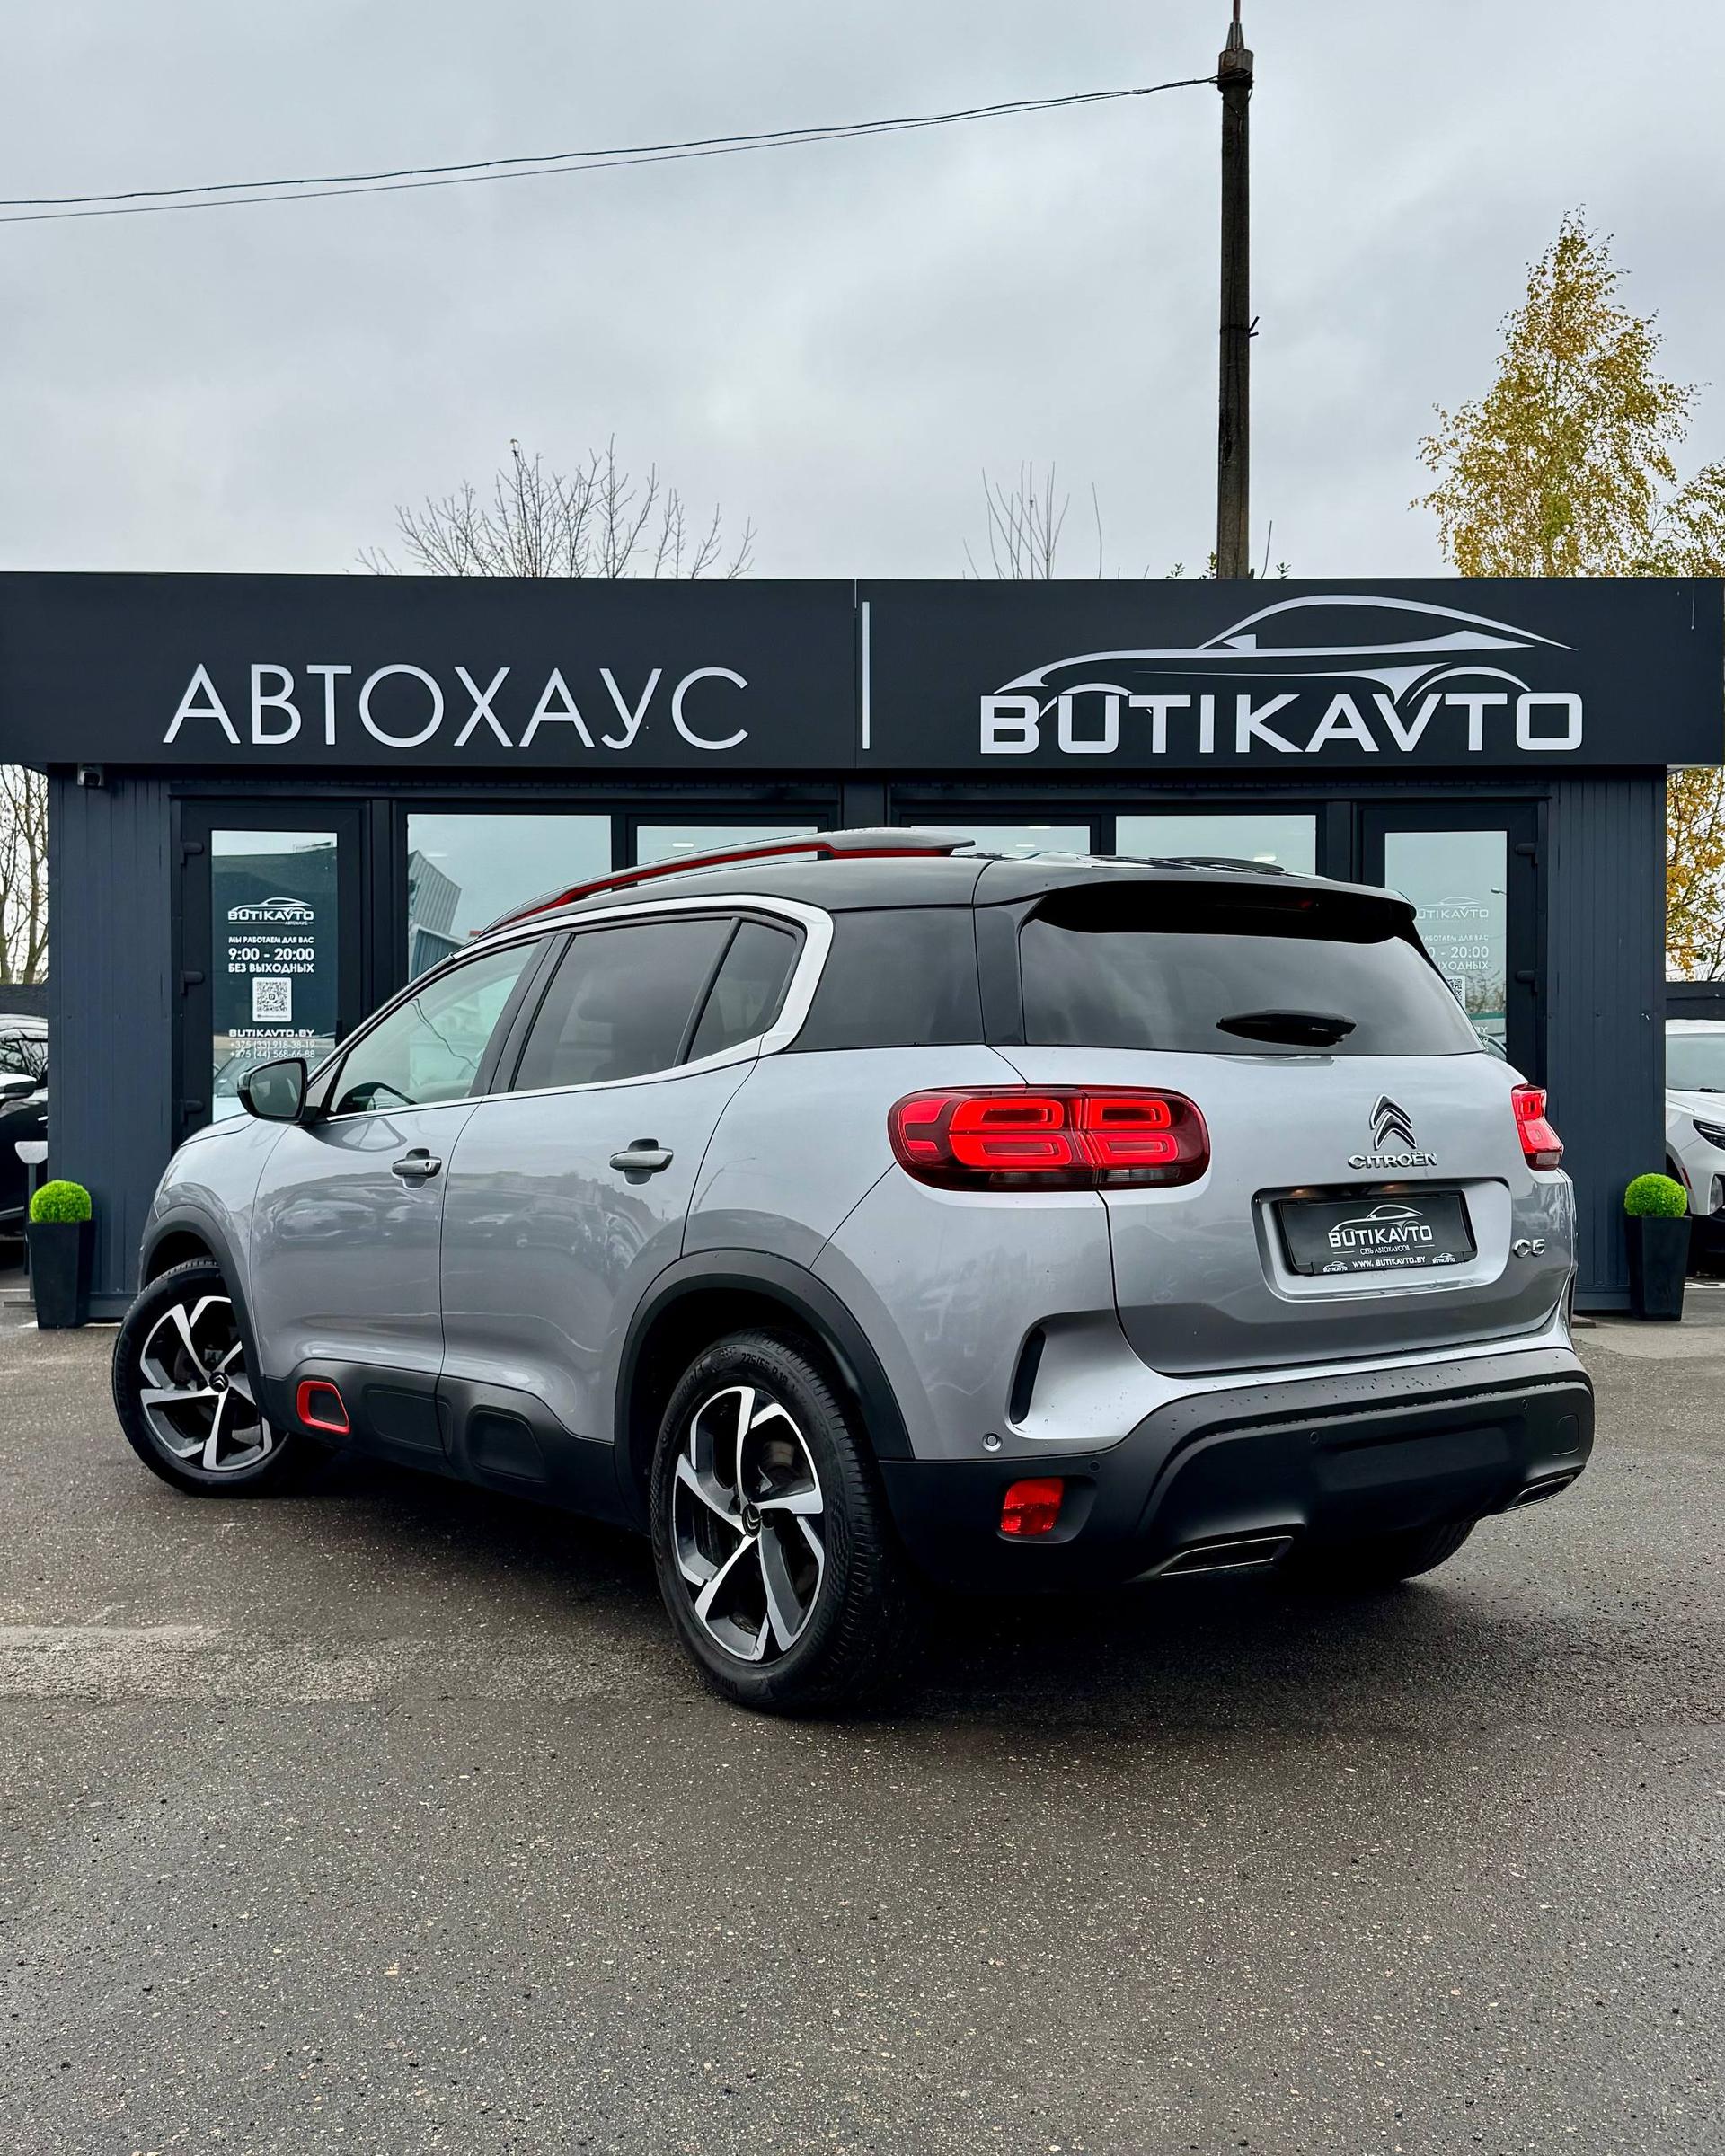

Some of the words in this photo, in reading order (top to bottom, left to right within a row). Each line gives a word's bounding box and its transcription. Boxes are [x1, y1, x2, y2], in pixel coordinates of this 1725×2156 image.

[163, 663, 749, 750] АВТОХАУС
[980, 692, 1584, 755] BUTIKAVTO
[227, 910, 314, 921] BUTIKAVTO
[1417, 909, 1489, 919] UTIKAVTO
[228, 936, 243, 944] МЫ
[243, 936, 281, 944] РАБОТАЕМ
[281, 936, 297, 944] ДЛЯ
[298, 936, 314, 944] ВАС
[228, 947, 260, 961] 9:00
[273, 947, 314, 961] 20:00
[1450, 945, 1490, 959] 20:00
[228, 963, 246, 973] БЕЗ
[248, 963, 314, 974] ВЫХОДНЫХ
[1438, 960, 1489, 970] ХОДНЫХ
[228, 1029, 315, 1038] BUTIKAVTO.BY
[253, 1049, 270, 1060] (44)
[272, 1049, 315, 1058] 568-66-88
[1348, 1151, 1438, 1170] CITROËN
[1328, 1225, 1433, 1248] BUTIKAVTO
[1512, 1238, 1546, 1258] C5
